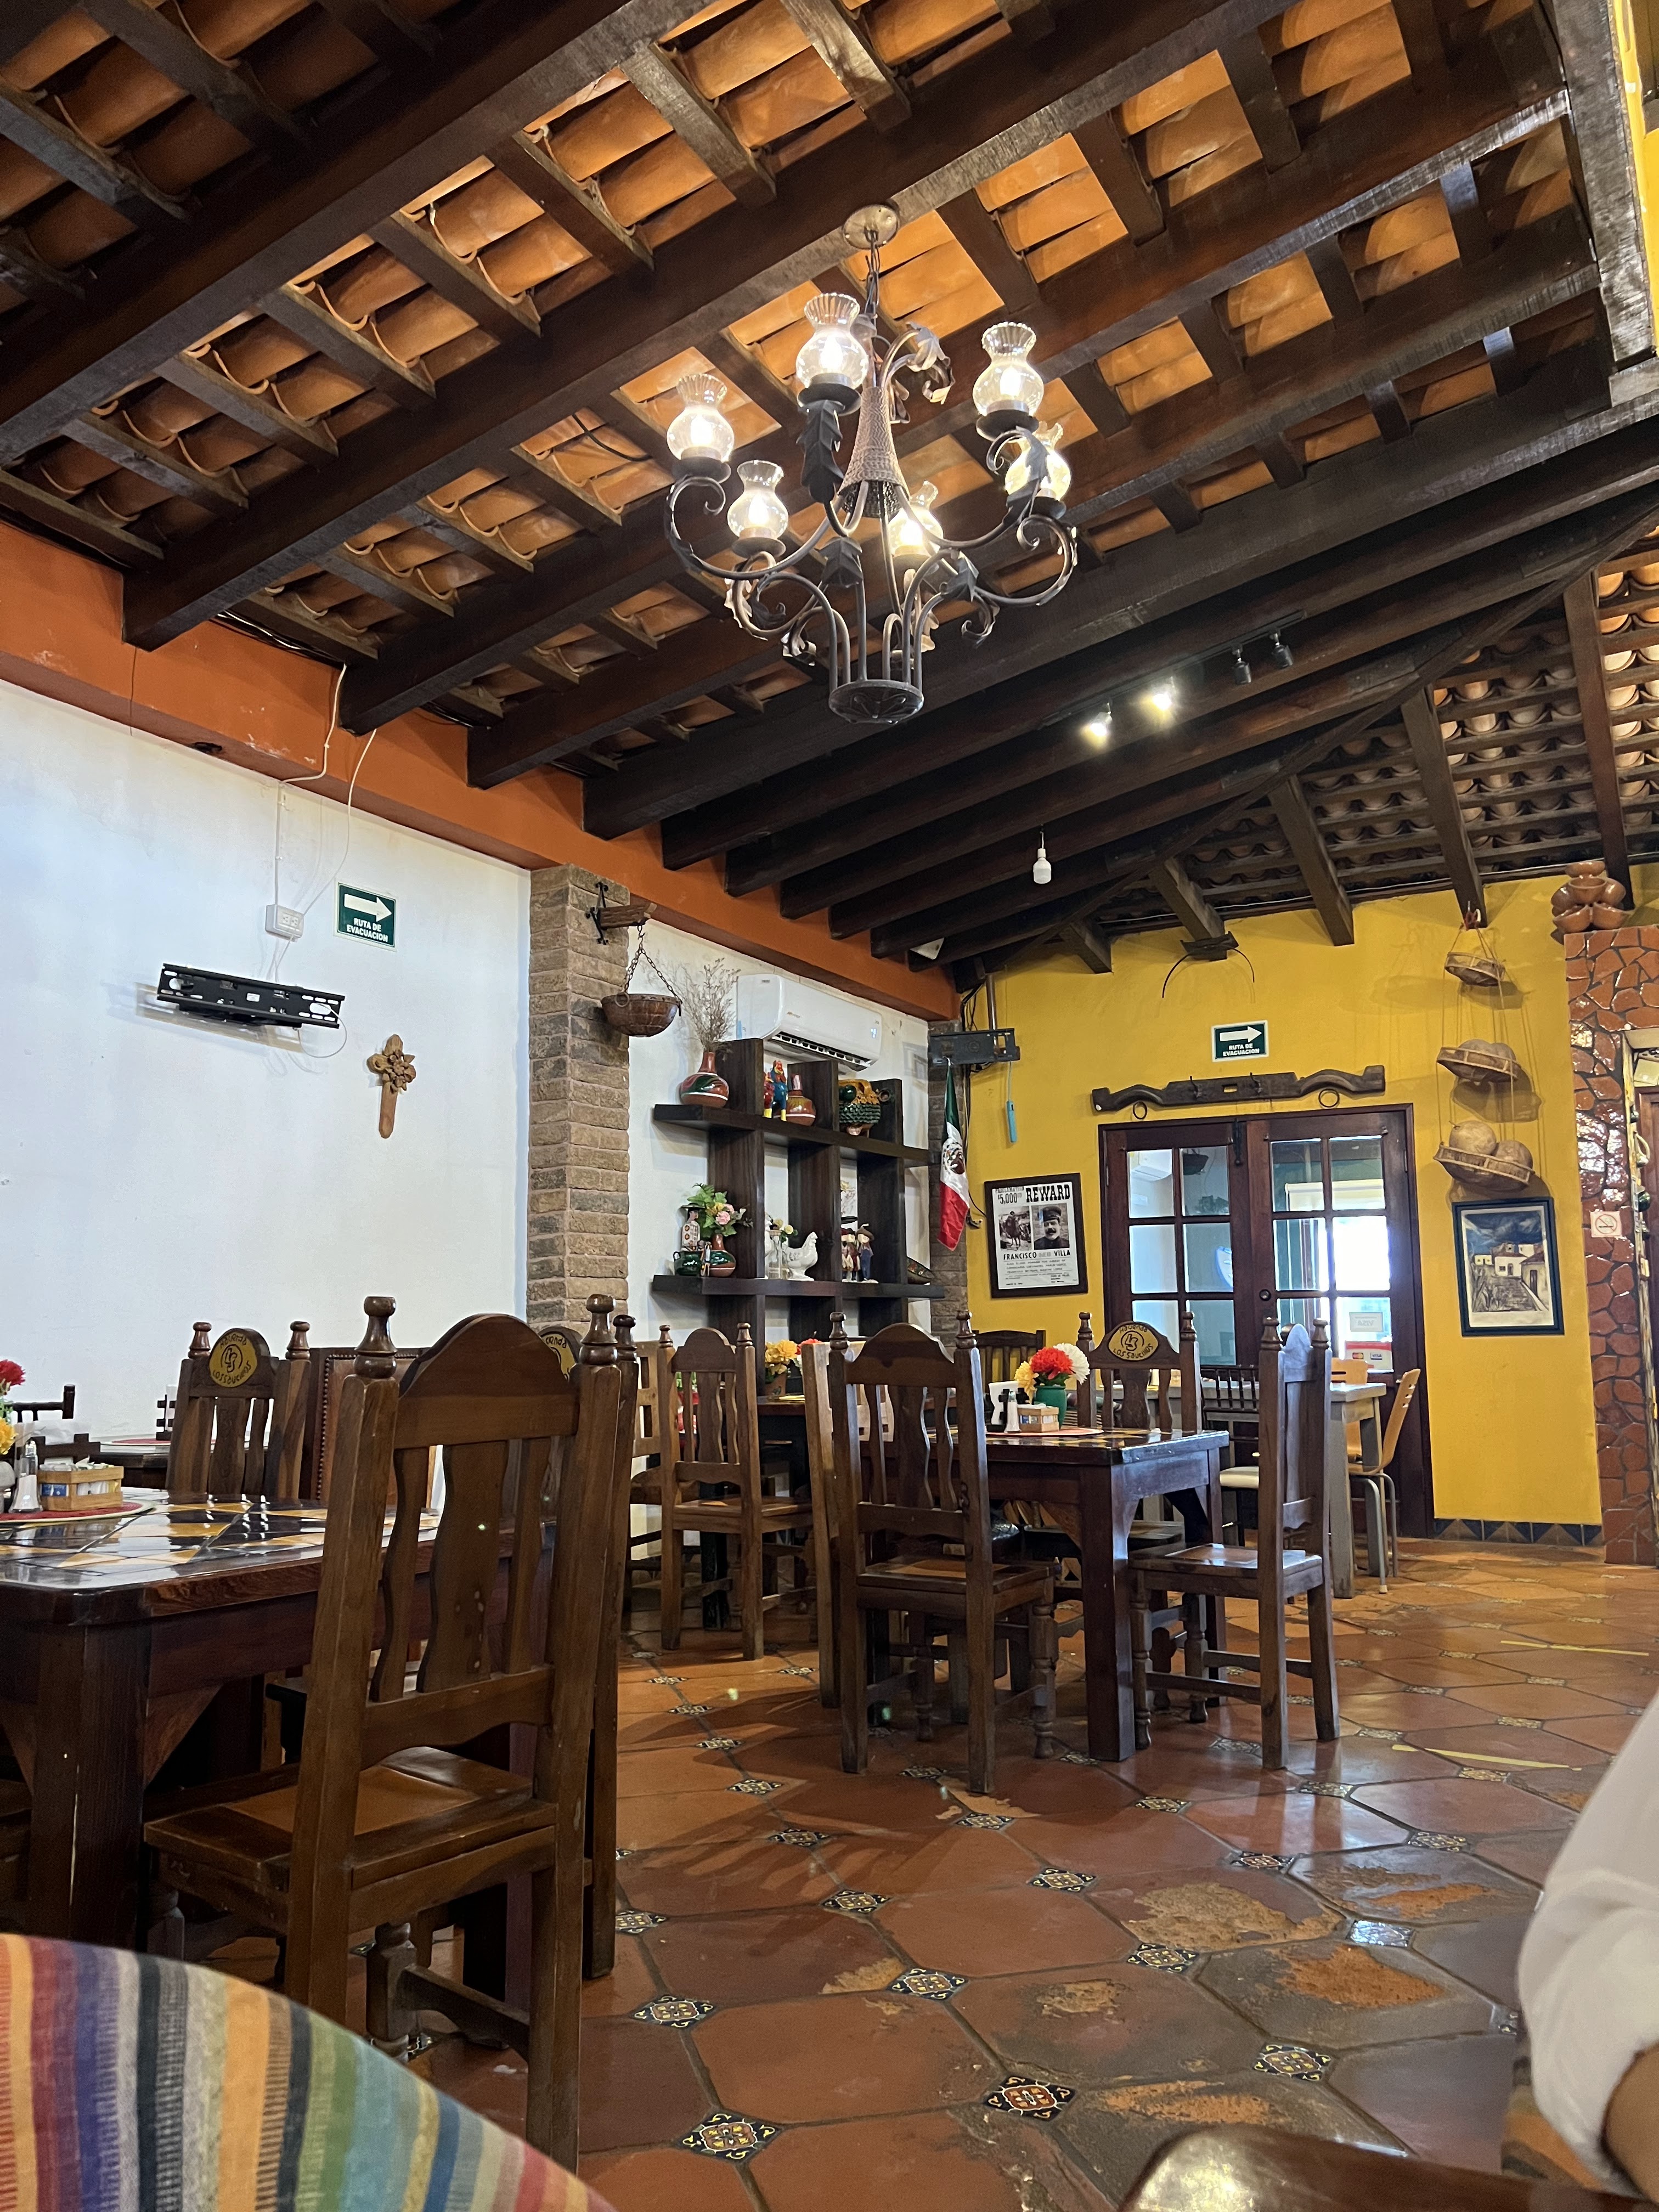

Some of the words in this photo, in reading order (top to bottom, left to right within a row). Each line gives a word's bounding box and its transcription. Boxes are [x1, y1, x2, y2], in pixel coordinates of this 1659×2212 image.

[354, 917, 371, 929] RUTA
[373, 923, 381, 932] DE
[347, 924, 388, 942] EVACUACION
[1222, 1048, 1260, 1057] EVACUACION
[1025, 1184, 1070, 1203] REWARD
[1003, 1251, 1037, 1260] FRANCISCO
